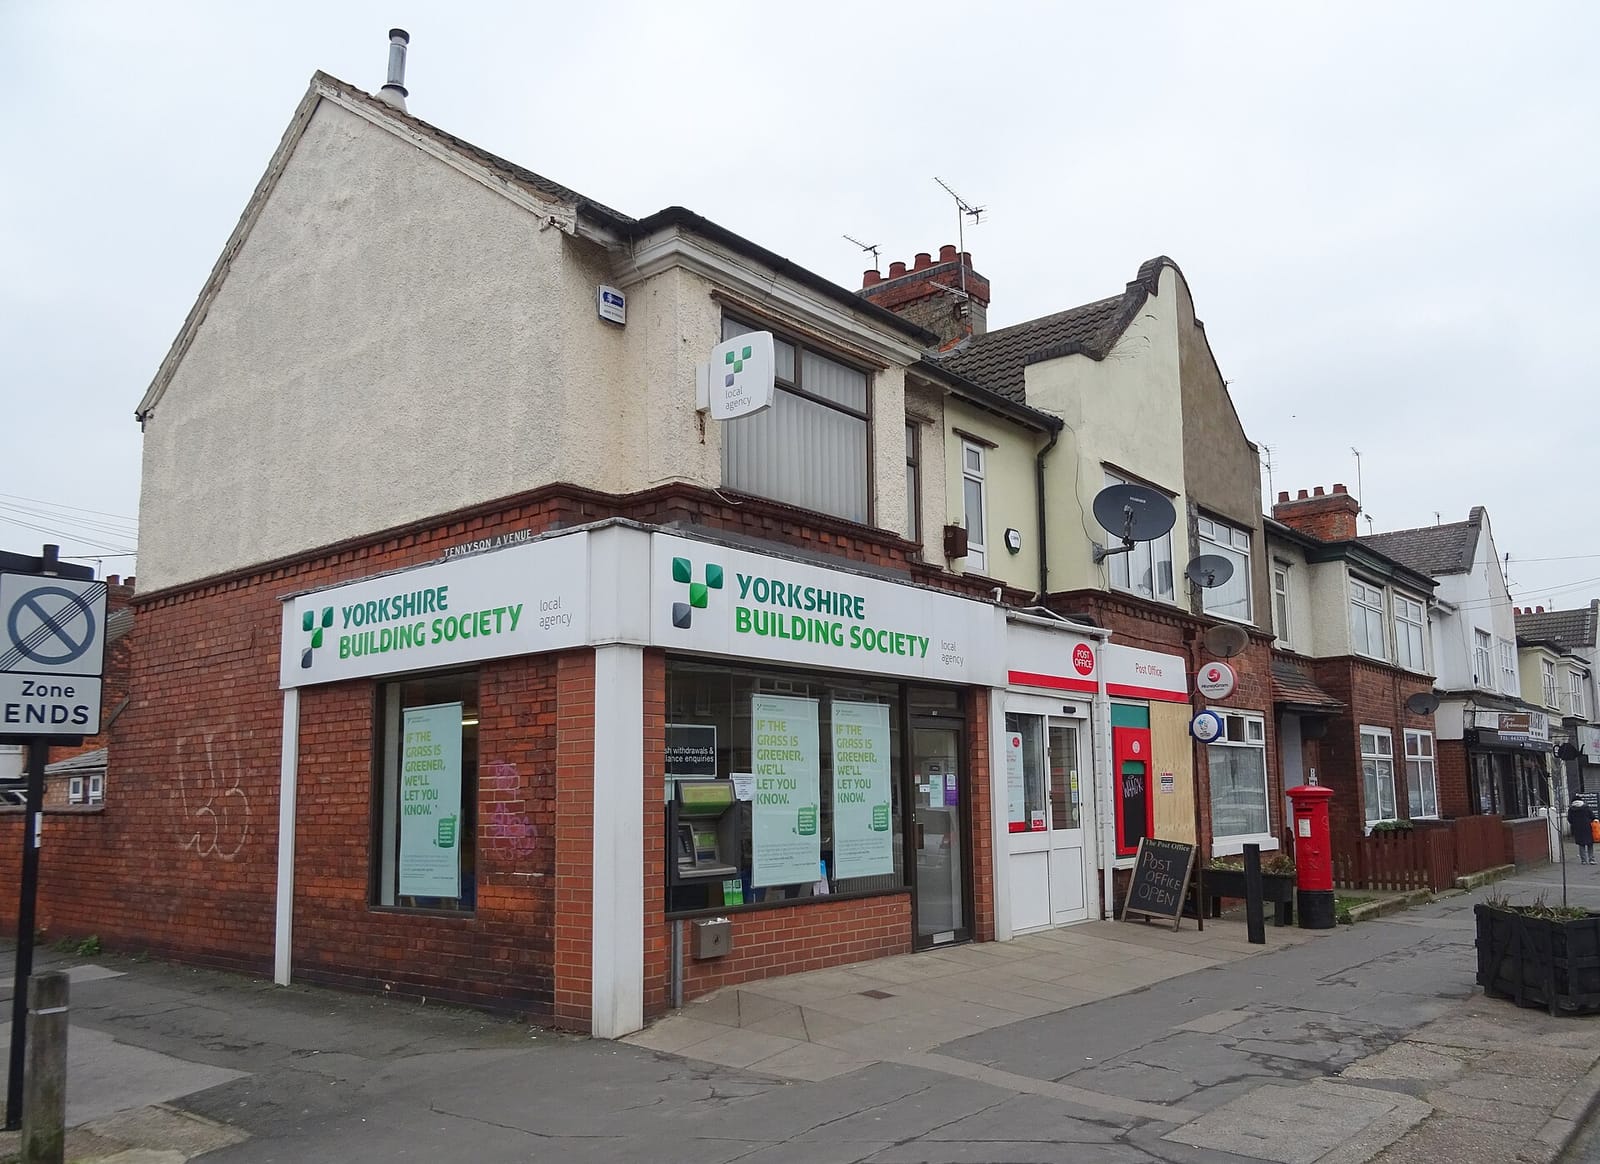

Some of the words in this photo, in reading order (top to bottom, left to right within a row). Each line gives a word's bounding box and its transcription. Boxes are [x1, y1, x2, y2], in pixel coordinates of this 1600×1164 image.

[725, 385, 743, 399] local
[725, 396, 751, 411] agency
[444, 539, 491, 557] TENNYSON
[736, 573, 865, 620] YORKSHIRE
[342, 586, 449, 629] YORKSHIRE
[540, 596, 561, 612] local
[539, 613, 573, 630] agency
[339, 622, 426, 659] BUILDING
[431, 603, 523, 644] SOCIETY
[735, 606, 844, 647] BUILDING
[850, 625, 930, 659] SOCIETY
[941, 639, 957, 652] local
[941, 653, 964, 667] agency
[1076, 649, 1090, 660] POST
[1074, 658, 1093, 669] OFFICE
[1135, 663, 1146, 675] Post
[1147, 665, 1162, 677] Office
[22, 680, 75, 698] Zone
[4, 703, 89, 725] ENDS
[757, 720, 765, 731] IF
[768, 720, 786, 732] THE
[836, 724, 844, 735] IF
[846, 725, 862, 736] THE
[406, 732, 414, 744] IF
[415, 731, 431, 742] THE
[757, 734, 788, 746] GRASS
[790, 736, 798, 747] IS
[836, 738, 863, 749] GRASS
[865, 739, 872, 749] IS
[406, 745, 432, 758] GRASS
[434, 744, 441, 756] IS
[673, 746, 708, 755] withdrawals
[709, 746, 714, 755] &
[757, 749, 804, 762] GREENER,
[837, 751, 877, 763] GREENER,
[405, 759, 446, 772] GREENER,
[684, 755, 714, 764] enquiries
[757, 763, 786, 775] WE'LL
[837, 765, 862, 776] WE'LL
[405, 775, 429, 787] WE'LL
[757, 778, 774, 790] LET
[777, 778, 797, 790] YOU
[837, 779, 852, 790] LET
[854, 778, 871, 789] YOU
[404, 790, 420, 801] LET
[421, 788, 438, 800] YOU
[757, 793, 790, 805] KNOW.
[837, 792, 865, 804] KNOW.
[404, 804, 432, 816] KNOW.
[1158, 841, 1170, 849] Post
[1171, 843, 1190, 852] Office
[1142, 851, 1172, 871] POST
[1145, 870, 1181, 890] OFFICE
[1138, 883, 1174, 906] OPEN
